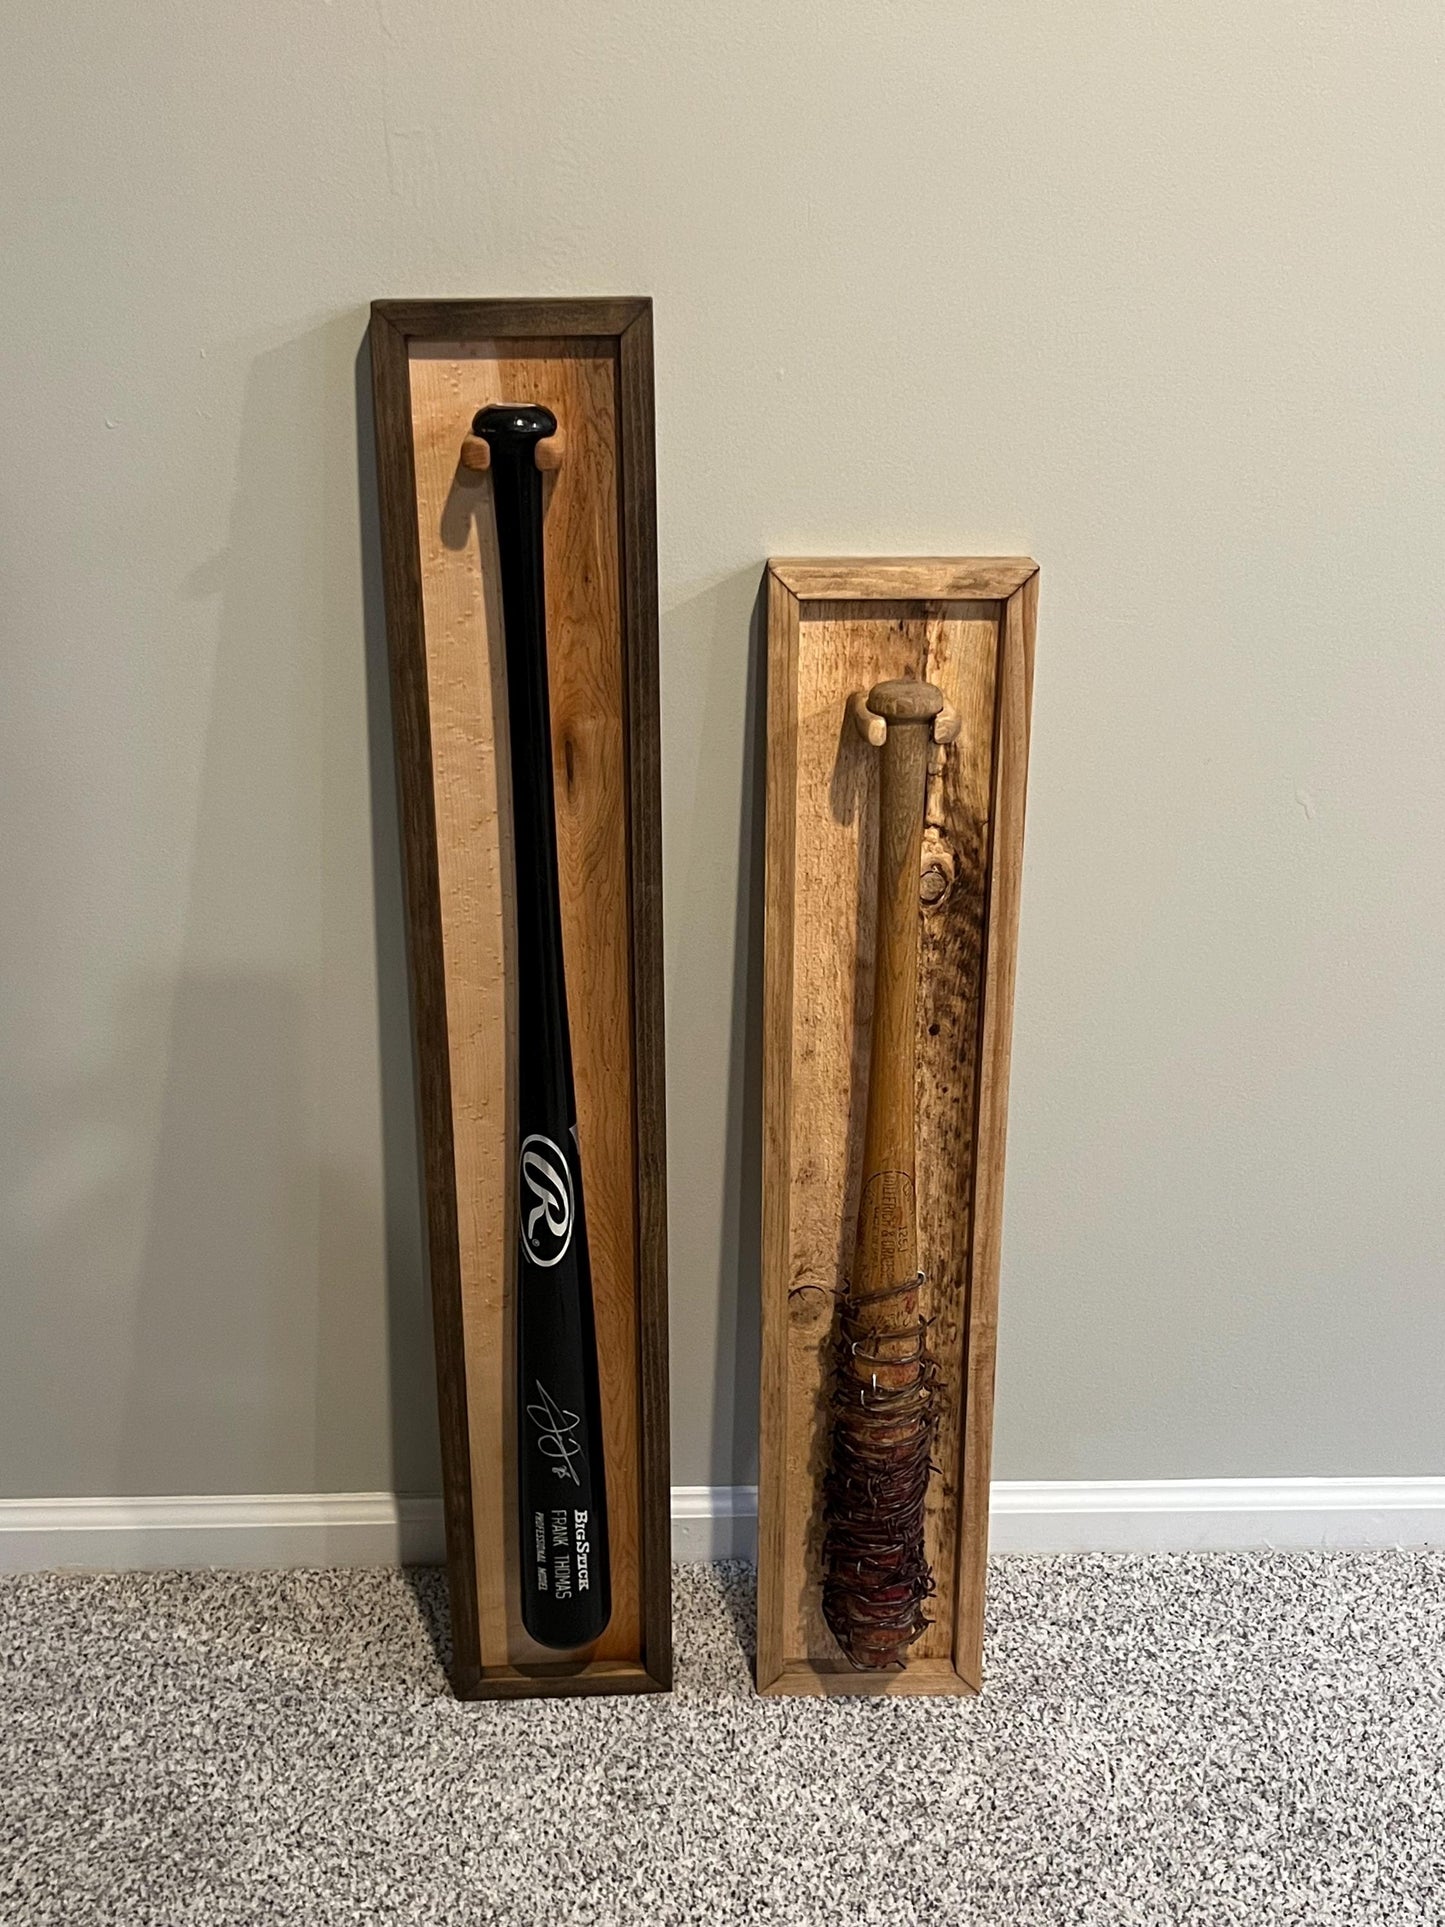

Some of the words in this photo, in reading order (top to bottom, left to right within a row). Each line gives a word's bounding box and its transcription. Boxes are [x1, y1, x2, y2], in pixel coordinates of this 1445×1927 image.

[881, 1229, 896, 1238] &
[535, 1511, 547, 1563] PROFESSIONAL
[551, 1509, 569, 1547] FRANK
[537, 1566, 549, 1591] MODEL
[554, 1554, 572, 1599] THOMAS
